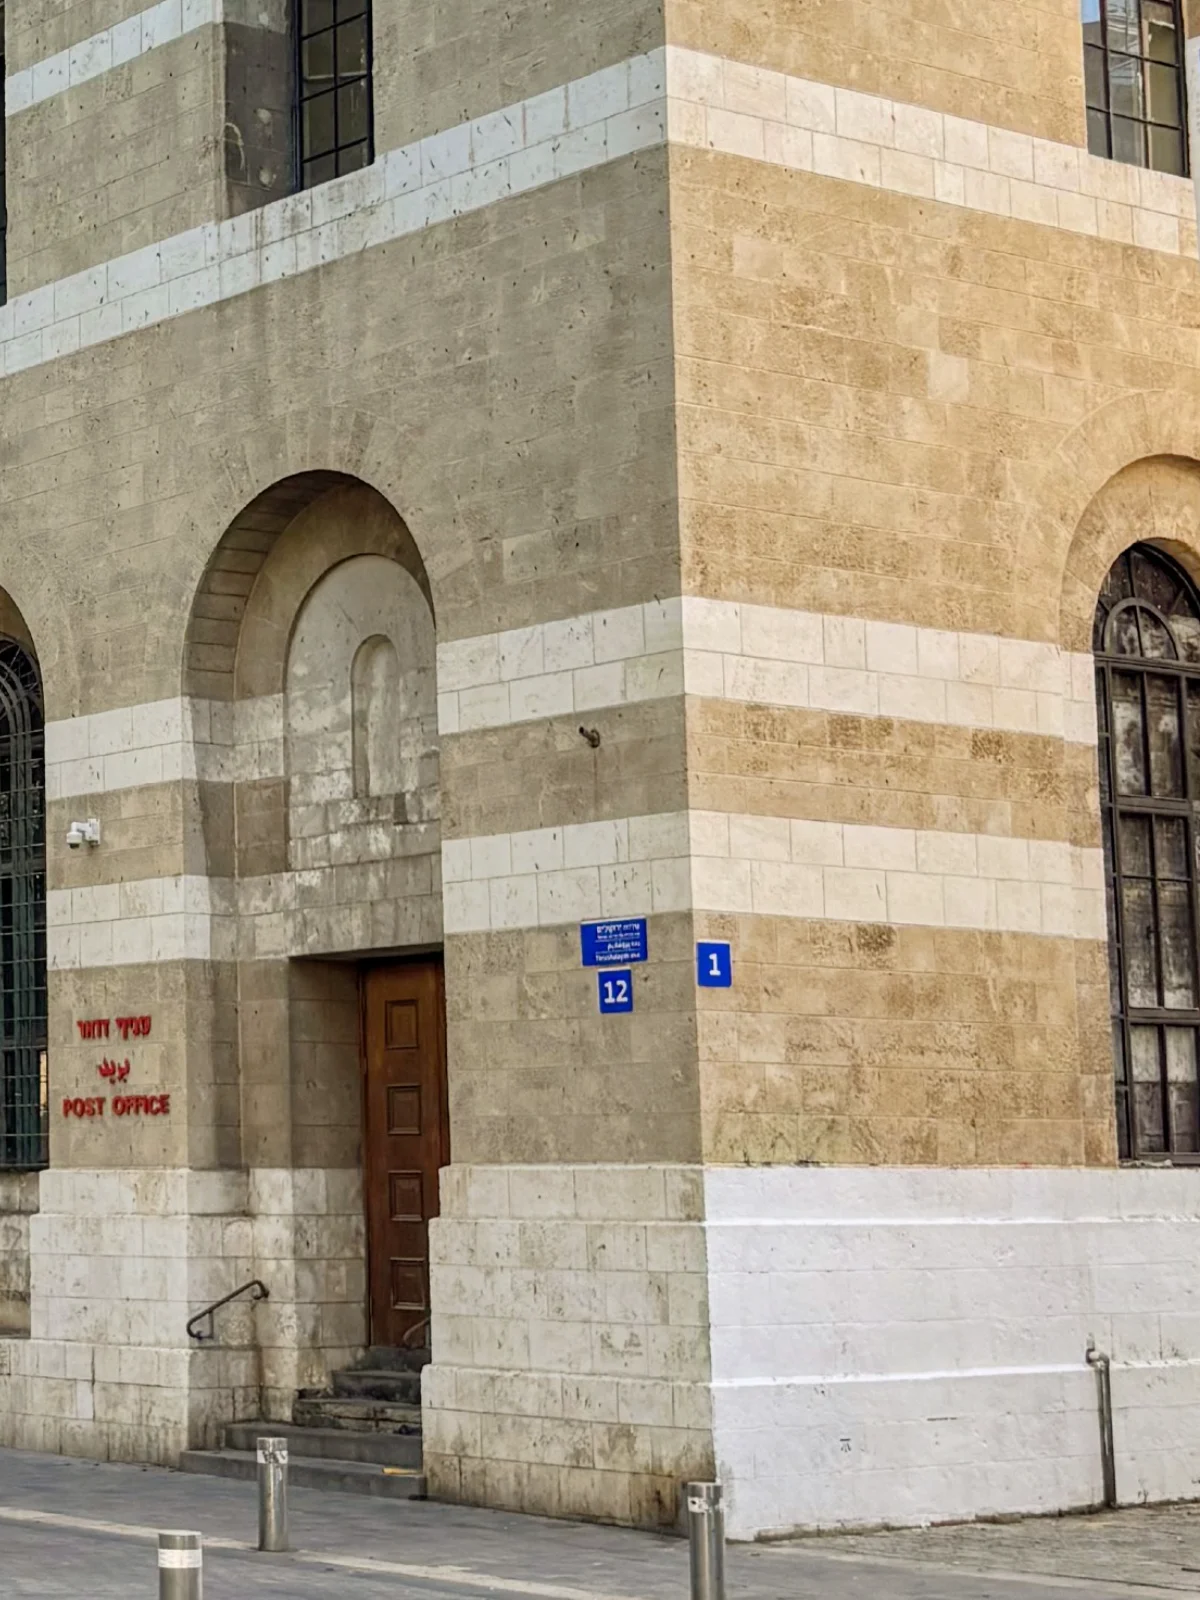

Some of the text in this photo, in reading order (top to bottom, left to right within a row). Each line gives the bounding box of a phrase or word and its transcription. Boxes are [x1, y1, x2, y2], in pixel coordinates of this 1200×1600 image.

[708, 953, 721, 976] 1
[604, 980, 628, 1004] 12
[76, 1015, 152, 1041] סניף דואר
[62, 1094, 171, 1118] POST OFFICE
